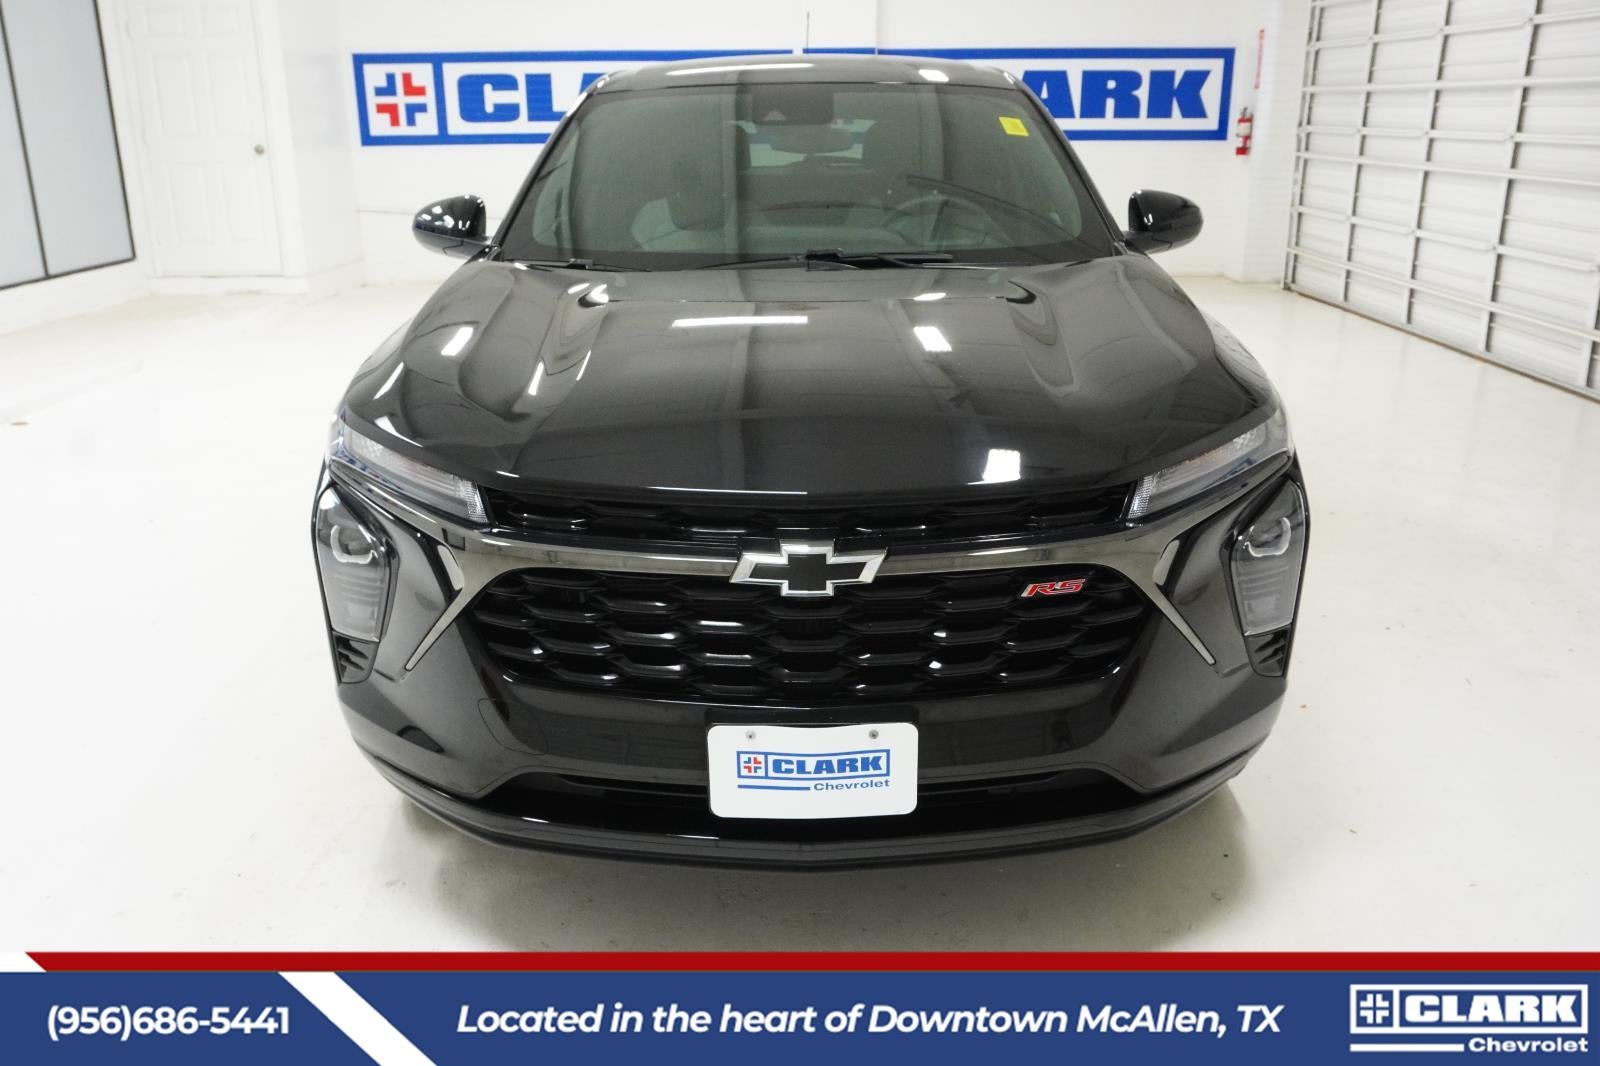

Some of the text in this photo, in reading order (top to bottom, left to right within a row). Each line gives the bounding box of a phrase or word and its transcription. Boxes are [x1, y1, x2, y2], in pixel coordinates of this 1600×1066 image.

[1020, 577, 1086, 598] RS
[772, 756, 883, 775] CLARK
[813, 779, 890, 791] Chevrolet
